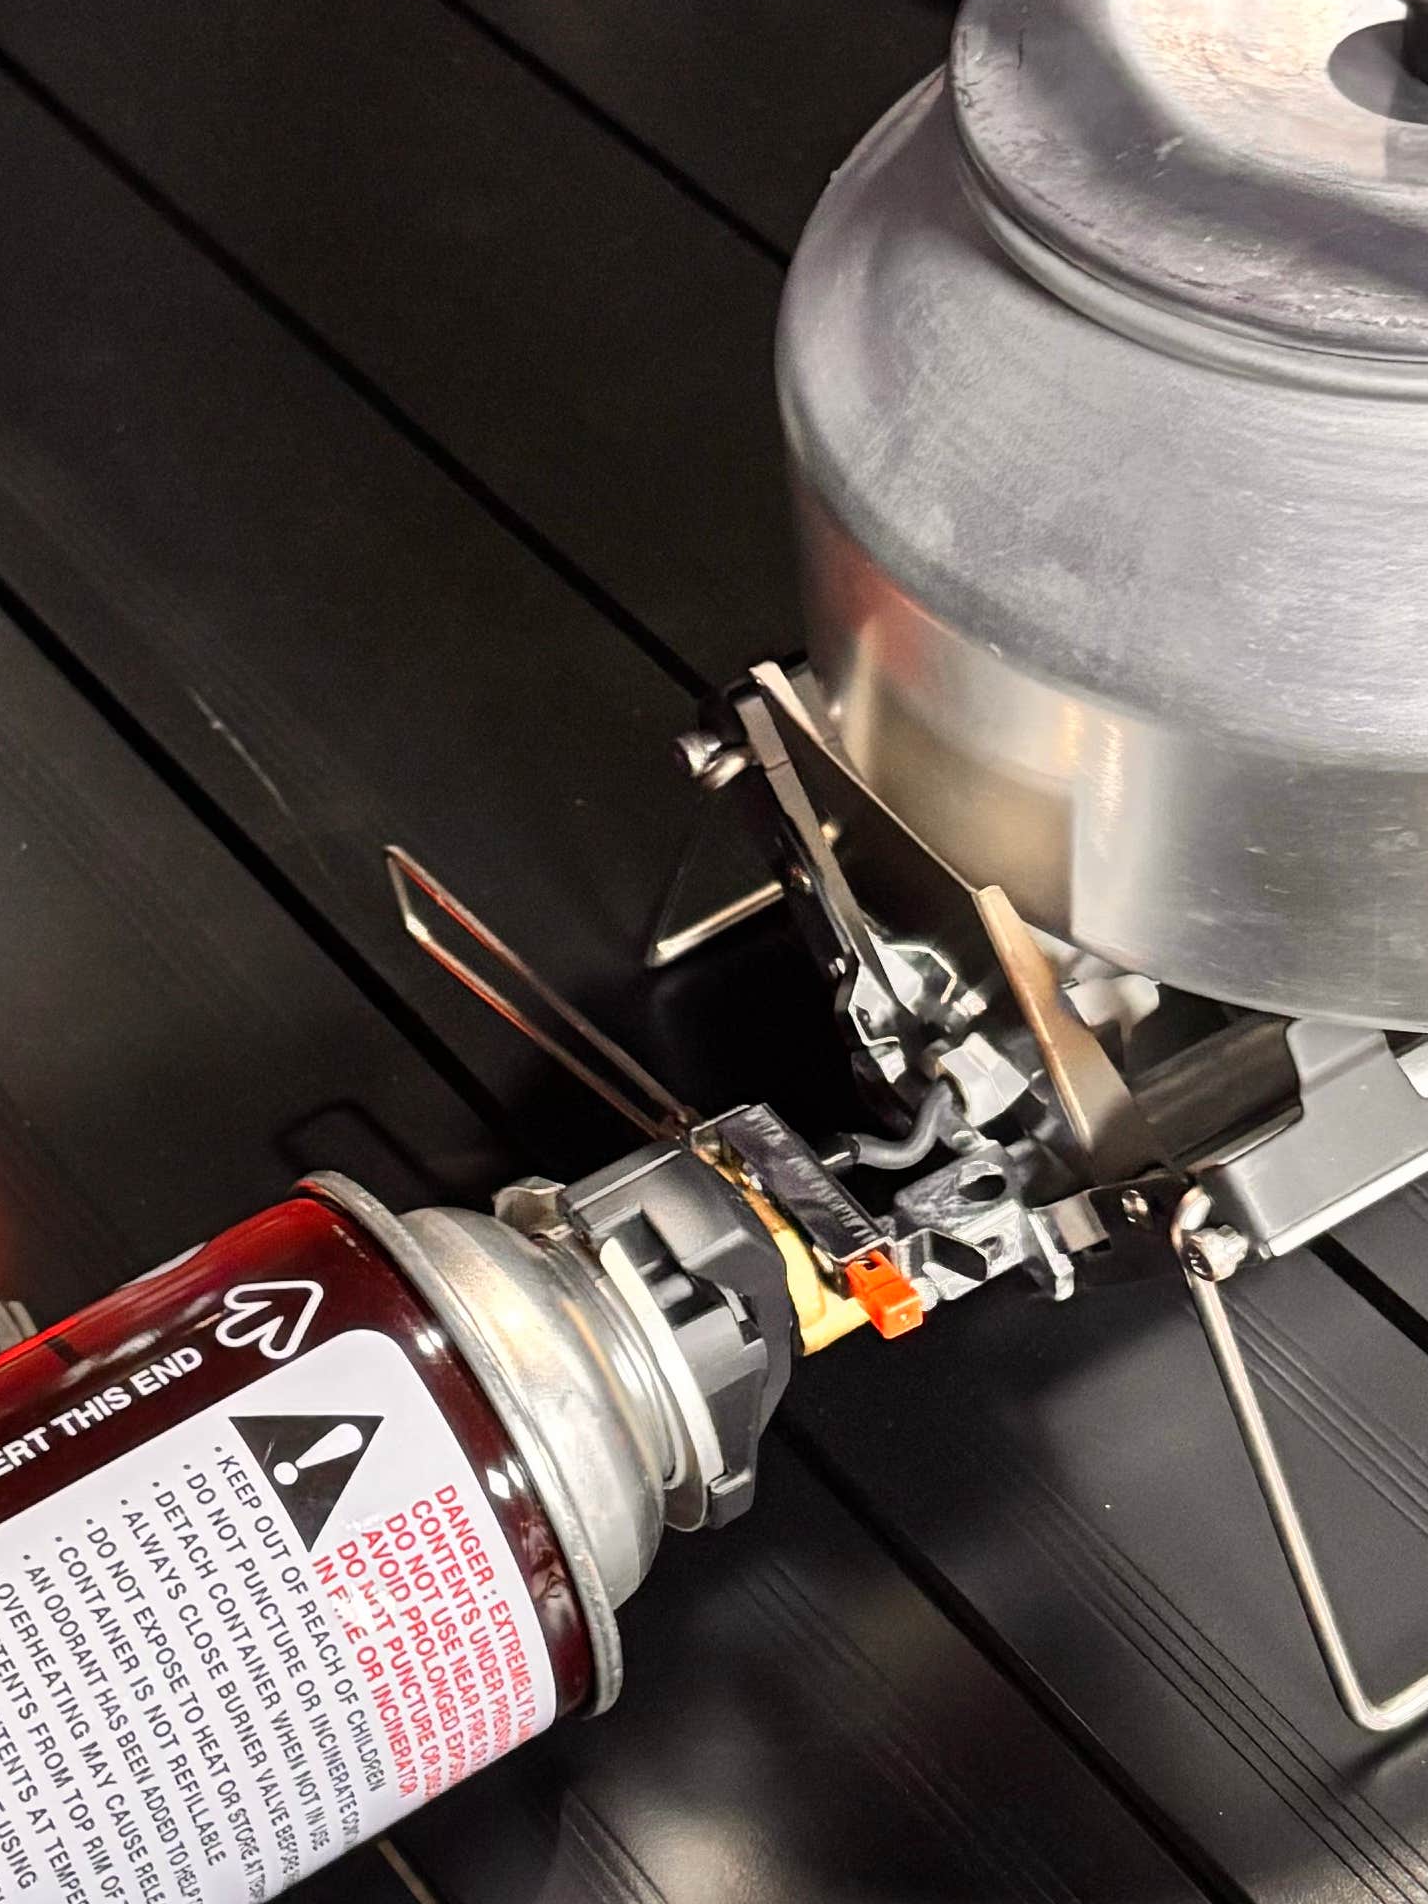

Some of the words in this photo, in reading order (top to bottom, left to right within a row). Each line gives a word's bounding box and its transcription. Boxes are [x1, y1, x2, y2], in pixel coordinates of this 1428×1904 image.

[49, 1386, 132, 1436] THIS
[129, 1347, 203, 1396] END
[186, 1472, 216, 1505] DO
[216, 1455, 263, 1509] KEEP
[86, 1526, 117, 1559] DO
[154, 1490, 219, 1580] DETACH
[207, 1507, 247, 1553] NOT
[254, 1515, 292, 1560] OUT
[24, 1566, 56, 1594] AN
[105, 1559, 146, 1604] NOT
[281, 1566, 309, 1595] OF
[312, 1555, 339, 1585] IN
[434, 1484, 495, 1587] DANGER
[475, 1599, 534, 1708] EXTREMELY
[234, 1557, 308, 1679] PUNCTURE
[384, 1512, 417, 1551] DO
[404, 1553, 444, 1603] NOT
[430, 1606, 464, 1657] USE
[449, 1654, 481, 1710] NEAR
[411, 1500, 482, 1626] CONTENTS
[469, 1625, 505, 1696] UNDER
[43, 1594, 109, 1687] ODORANT
[132, 1606, 191, 1694] EXPOSE
[208, 1582, 282, 1710] CONTAINER
[296, 1599, 346, 1677] REACH
[336, 1540, 367, 1579] DO
[383, 1635, 437, 1747] PUNCTURE
[419, 1744, 441, 1770] OR
[361, 1530, 411, 1603] AVOID
[399, 1605, 461, 1732] PROLONGED
[122, 1511, 187, 1601] ALWAYS
[178, 1604, 229, 1680] CLOSE
[216, 1680, 268, 1769] BURNER
[255, 1767, 290, 1827] VALVE
[356, 1645, 385, 1683] OR
[58, 1546, 141, 1675] CONTAINER
[129, 1675, 155, 1702] IS
[143, 1704, 181, 1750] NOT
[166, 1753, 227, 1867] REFILLABLE
[93, 1687, 129, 1732] HAS
[178, 1691, 205, 1724] TO
[296, 1679, 322, 1713] OR
[334, 1678, 360, 1705] OF
[115, 1730, 155, 1785] BEEN
[191, 1724, 231, 1777] HEAT
[270, 1709, 308, 1771] WHEN
[308, 1712, 358, 1814] INCINERATE
[346, 1709, 387, 1792] CHILDREN
[354, 1682, 430, 1798] INCINERATOR
[27, 1721, 75, 1789] FROM
[62, 1787, 96, 1832] TOP
[82, 1835, 114, 1875] RIM
[100, 1875, 126, 1899] OF
[78, 1740, 118, 1789] MAY
[105, 1793, 149, 1864] CAUSE
[140, 1786, 180, 1844] ADDED
[217, 1779, 241, 1810] OR
[293, 1770, 321, 1806] NOT
[26, 1808, 56, 1834] AT
[227, 1807, 260, 1861] STORE
[304, 1806, 325, 1826] IN
[309, 1823, 331, 1852] USE
[166, 1840, 189, 1866] TO
[244, 1858, 265, 1876] AT
[173, 1863, 201, 1898] HELP
